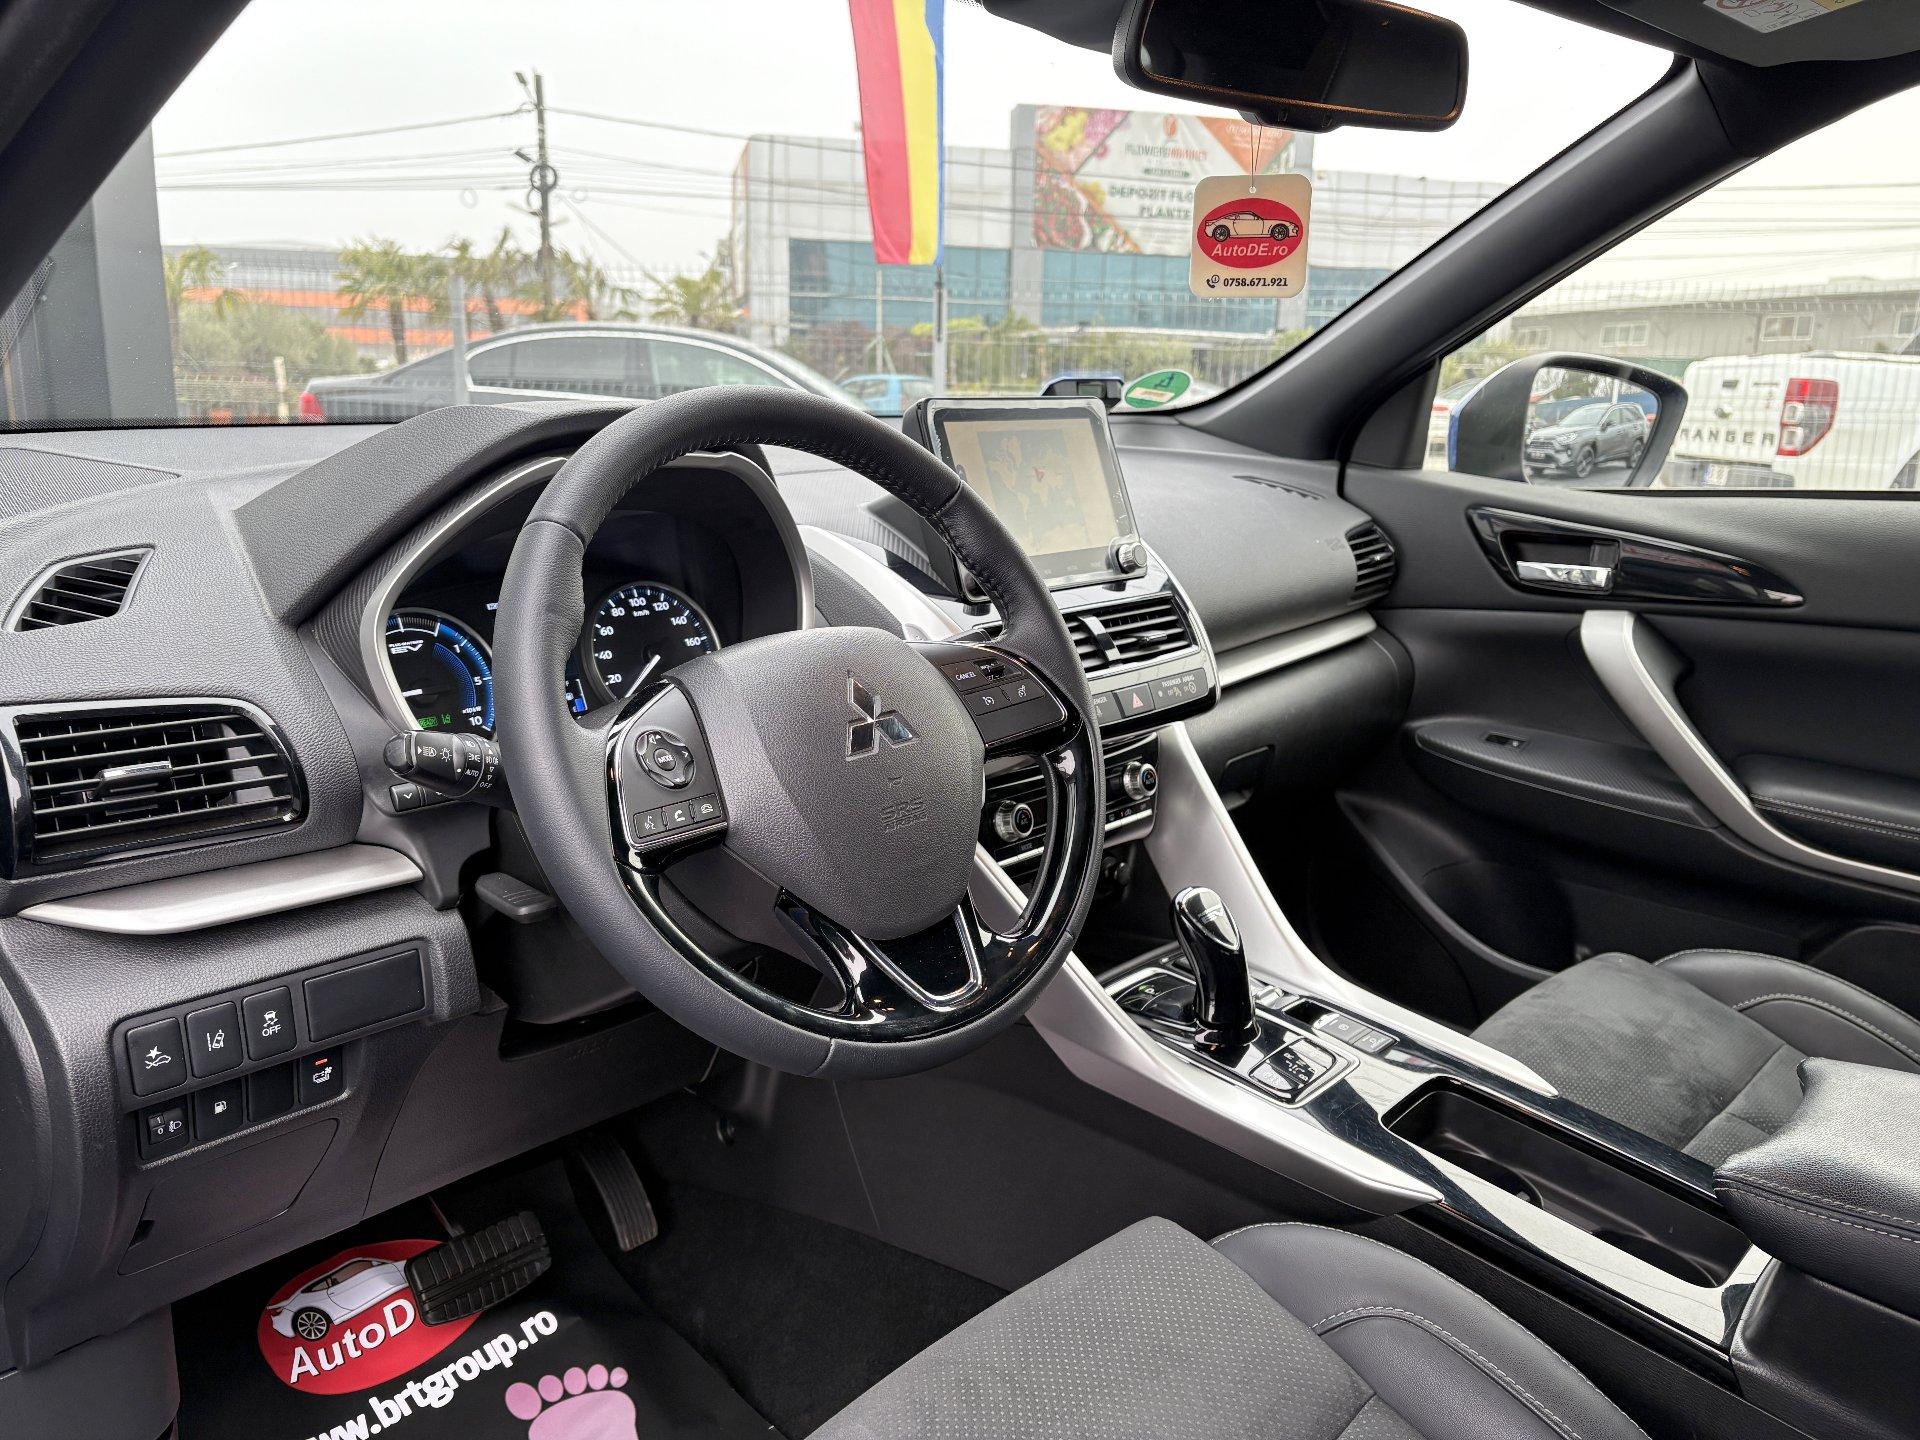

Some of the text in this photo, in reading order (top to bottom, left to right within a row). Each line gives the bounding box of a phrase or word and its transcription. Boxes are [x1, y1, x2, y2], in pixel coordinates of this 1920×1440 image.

[1108, 183, 1193, 202] DEPOZIT FLO
[1211, 242, 1289, 257] AutoDE.ro
[1223, 276, 1289, 288] 0758.671.921
[1679, 427, 1776, 446] RANGER
[629, 597, 647, 607] 100
[652, 601, 670, 612] 120
[611, 606, 626, 618] 80
[671, 615, 688, 626] 140
[599, 625, 614, 637] 60
[684, 636, 702, 647] 160
[598, 649, 613, 661] 40
[473, 675, 483, 686] 5
[606, 672, 622, 684] 20
[955, 671, 977, 681] CANCEL
[469, 715, 483, 727] 10
[464, 768, 480, 778] AUTO
[479, 781, 493, 789] OFF
[261, 1024, 282, 1037] OFF
[289, 1299, 416, 1384] AutoD
